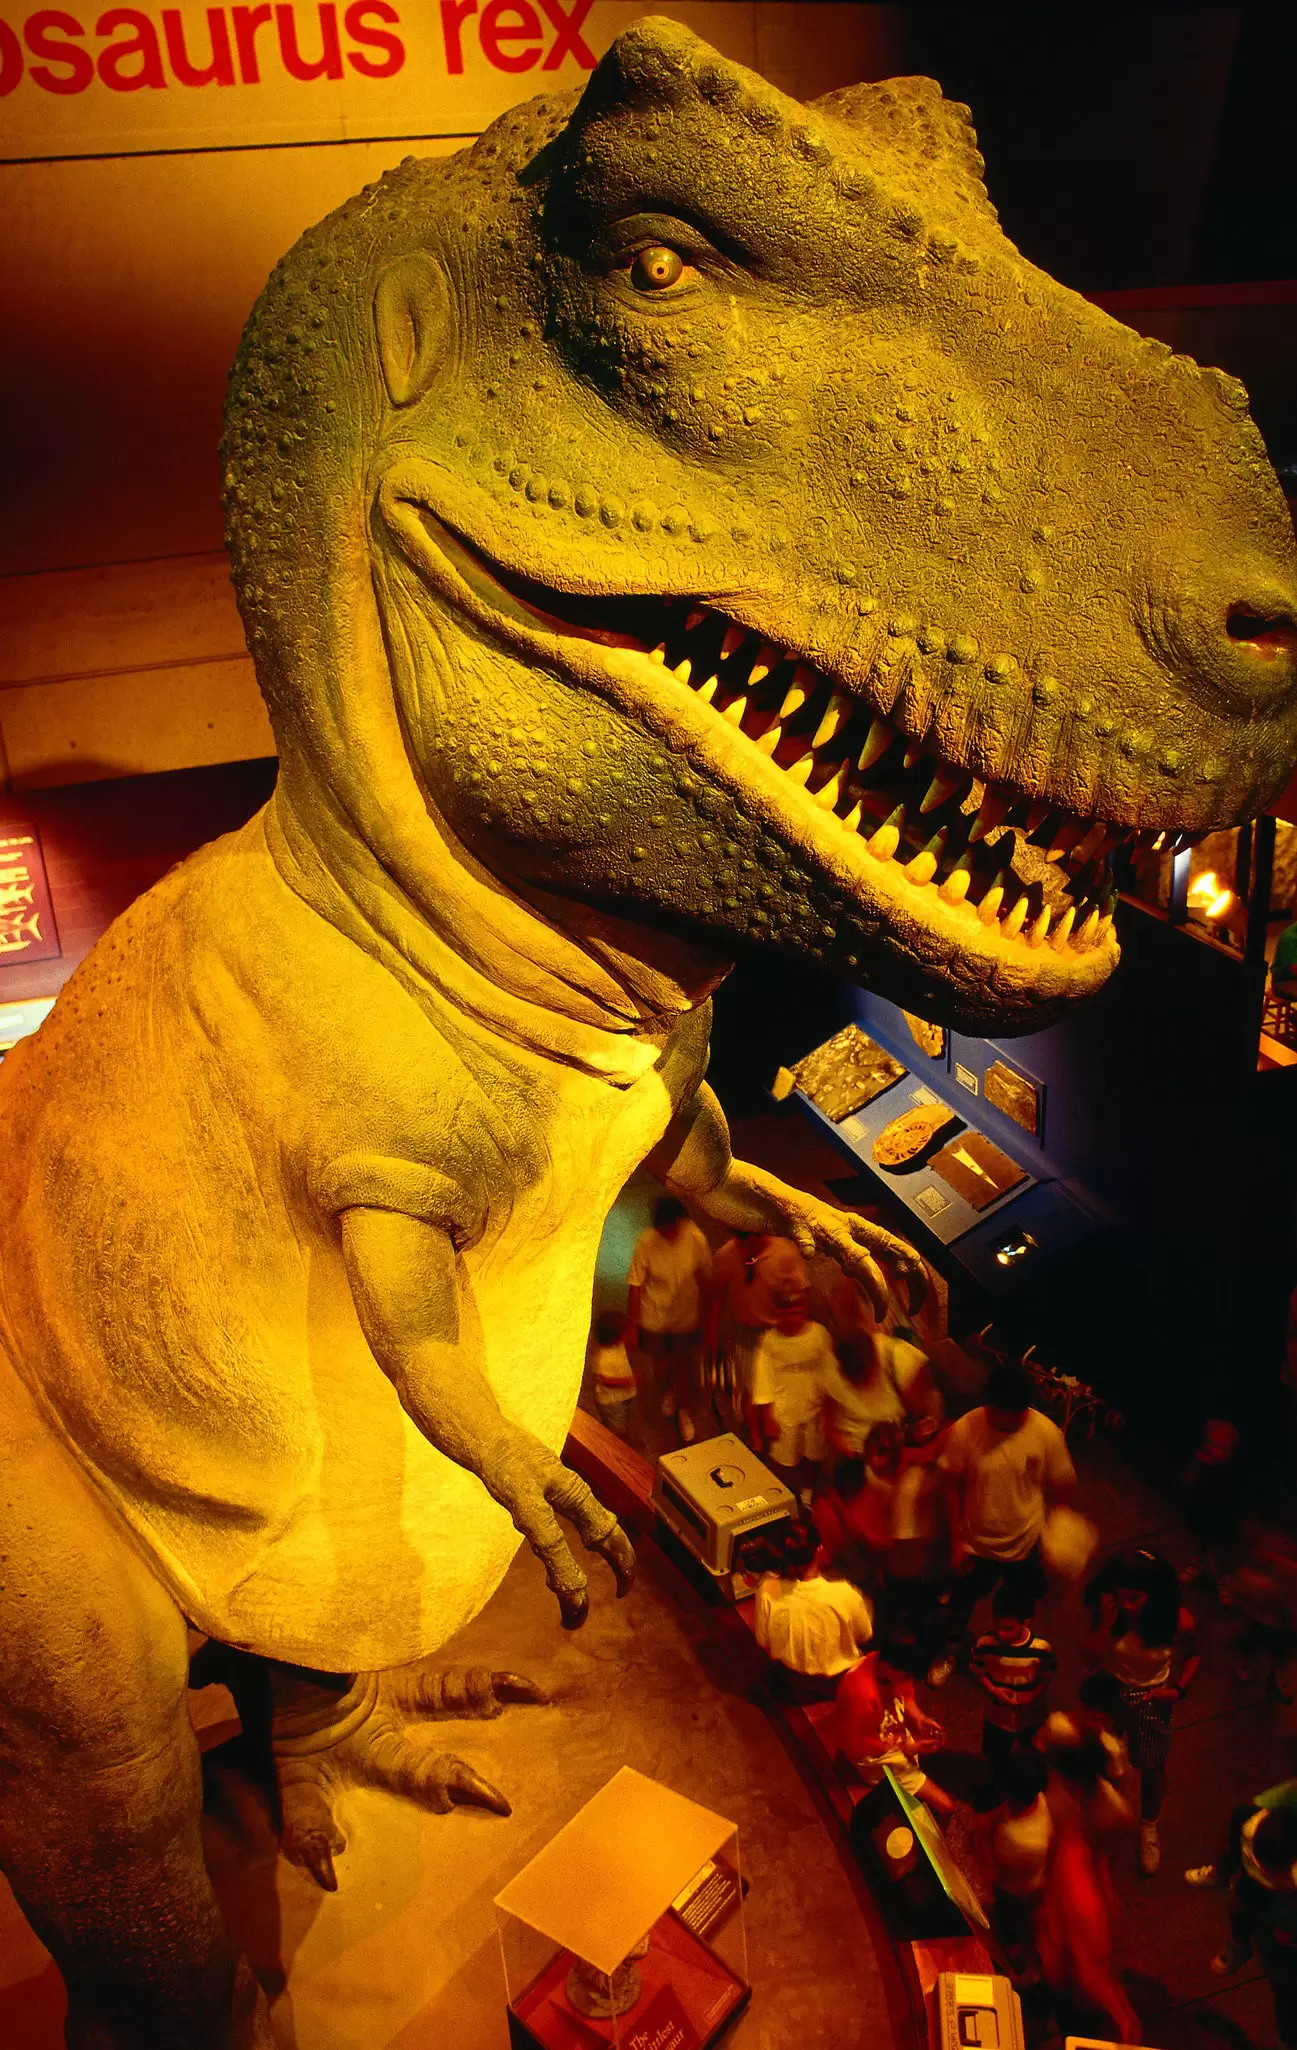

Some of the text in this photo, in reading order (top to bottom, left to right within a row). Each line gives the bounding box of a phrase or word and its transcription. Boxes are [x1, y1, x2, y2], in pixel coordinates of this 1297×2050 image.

[439, 0, 599, 75] rex
[629, 2032, 649, 2050] The
[643, 2021, 675, 2050] ittlest
